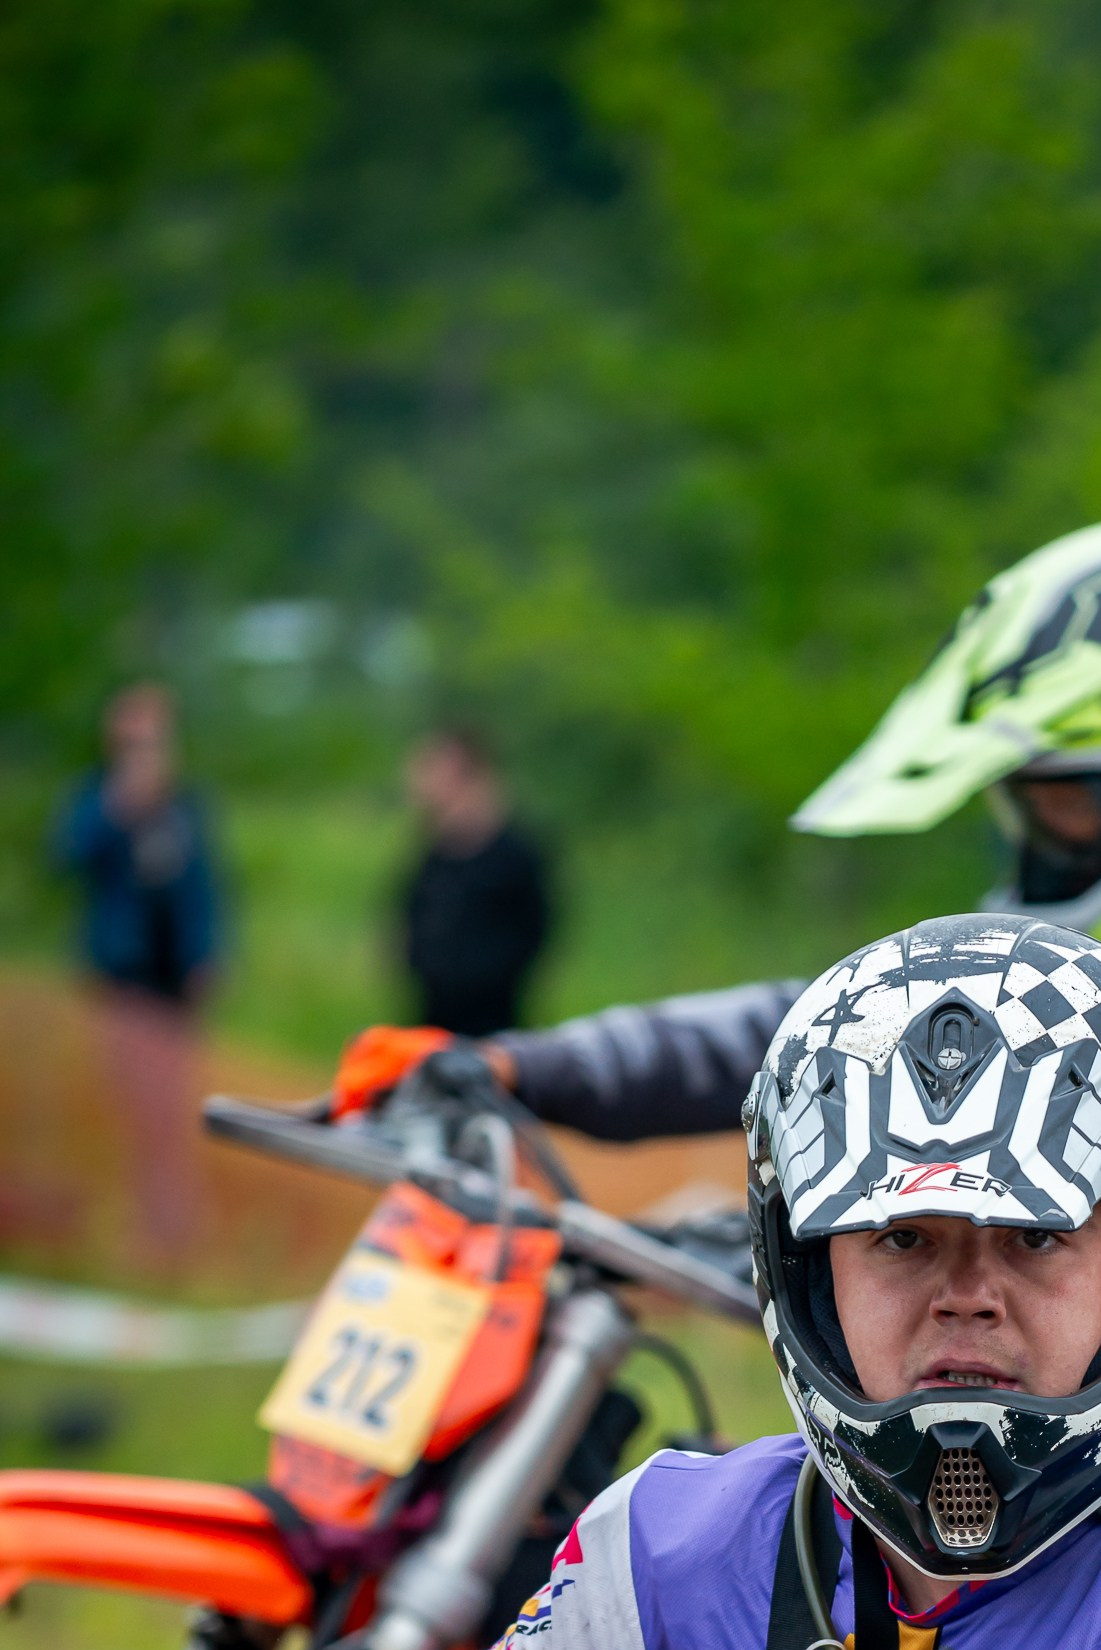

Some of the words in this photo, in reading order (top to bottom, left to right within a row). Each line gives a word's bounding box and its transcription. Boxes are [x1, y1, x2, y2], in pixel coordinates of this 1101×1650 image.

[862, 1162, 1013, 1201] HIZER
[304, 1328, 421, 1430] 212
[516, 1619, 552, 1636] RAC
